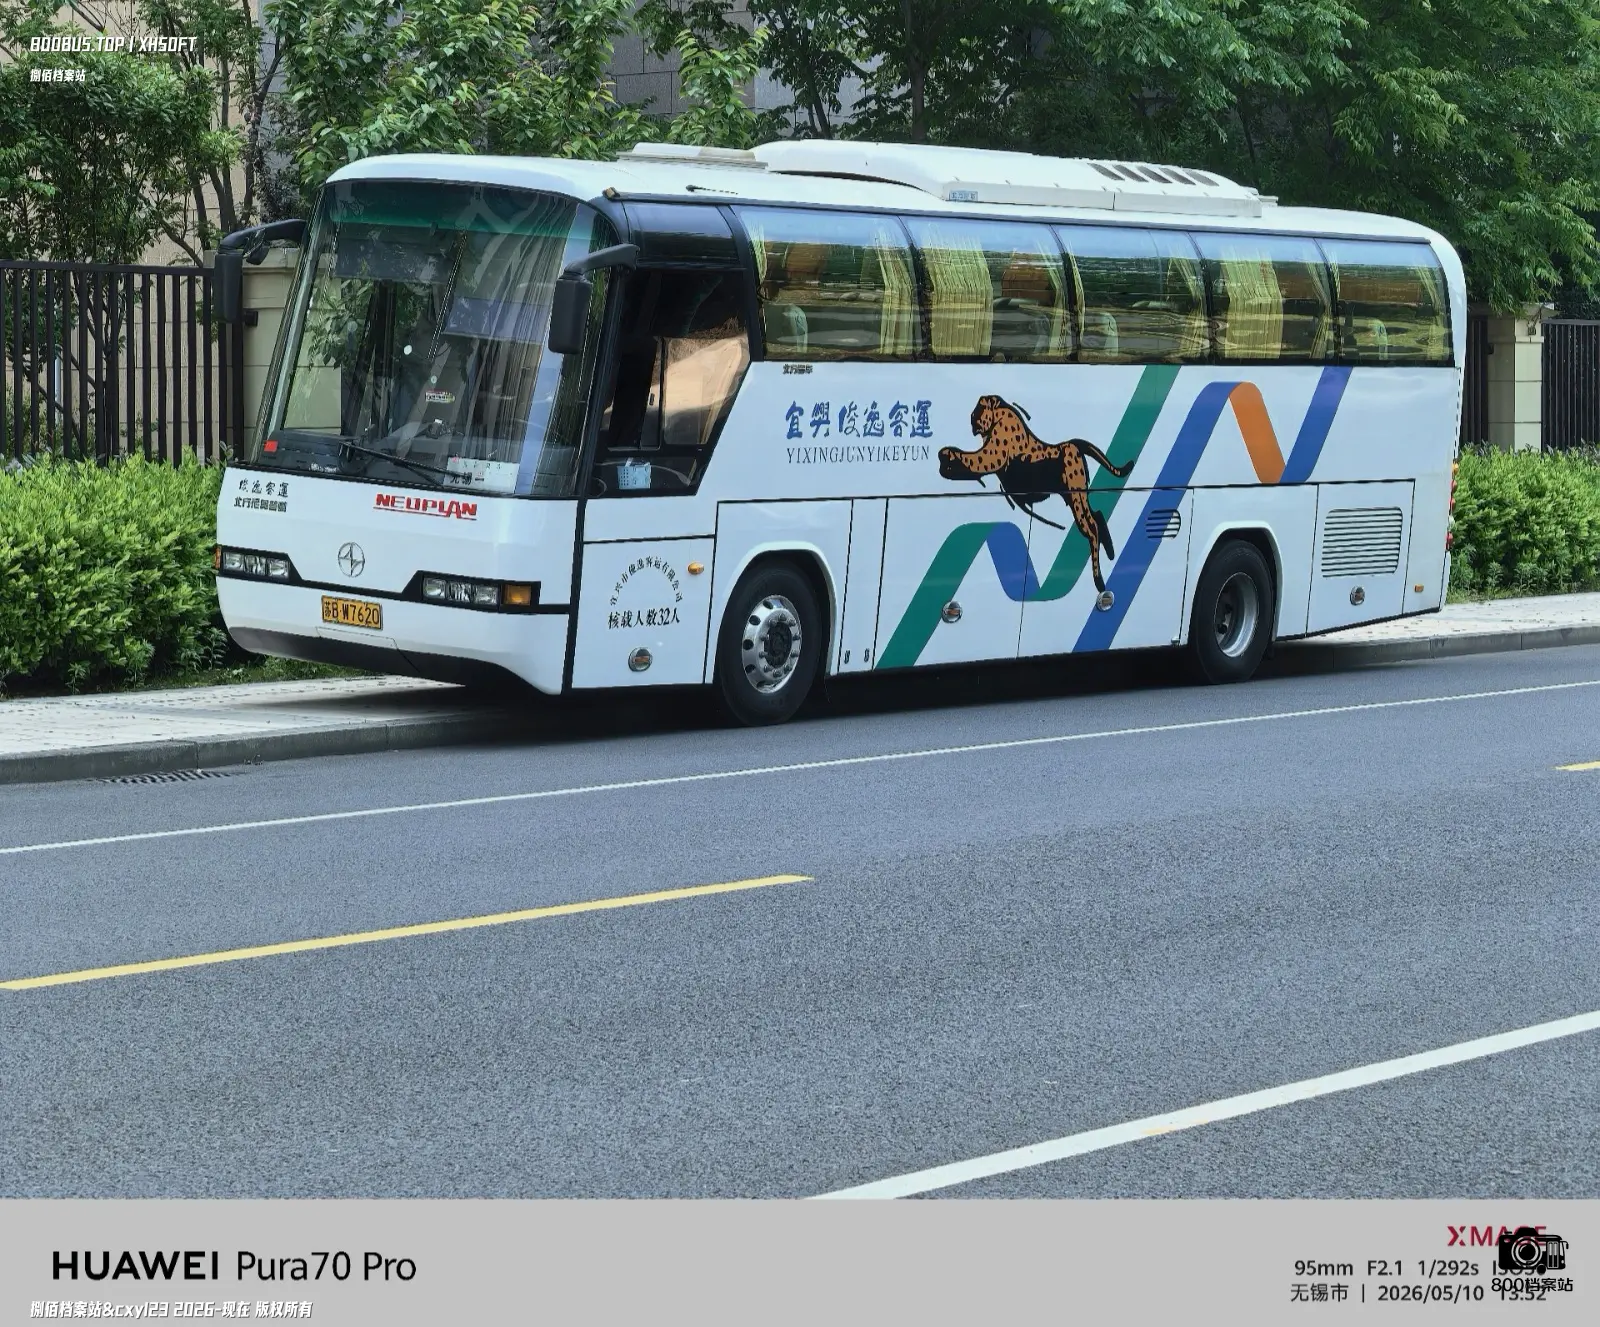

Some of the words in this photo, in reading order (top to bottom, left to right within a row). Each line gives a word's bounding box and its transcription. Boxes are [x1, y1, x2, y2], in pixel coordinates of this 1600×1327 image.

[786, 445, 930, 464] YIXINGJUNYIKEYUN
[375, 493, 478, 520] NEOPLAN
[608, 607, 680, 630] 核载人数32人
